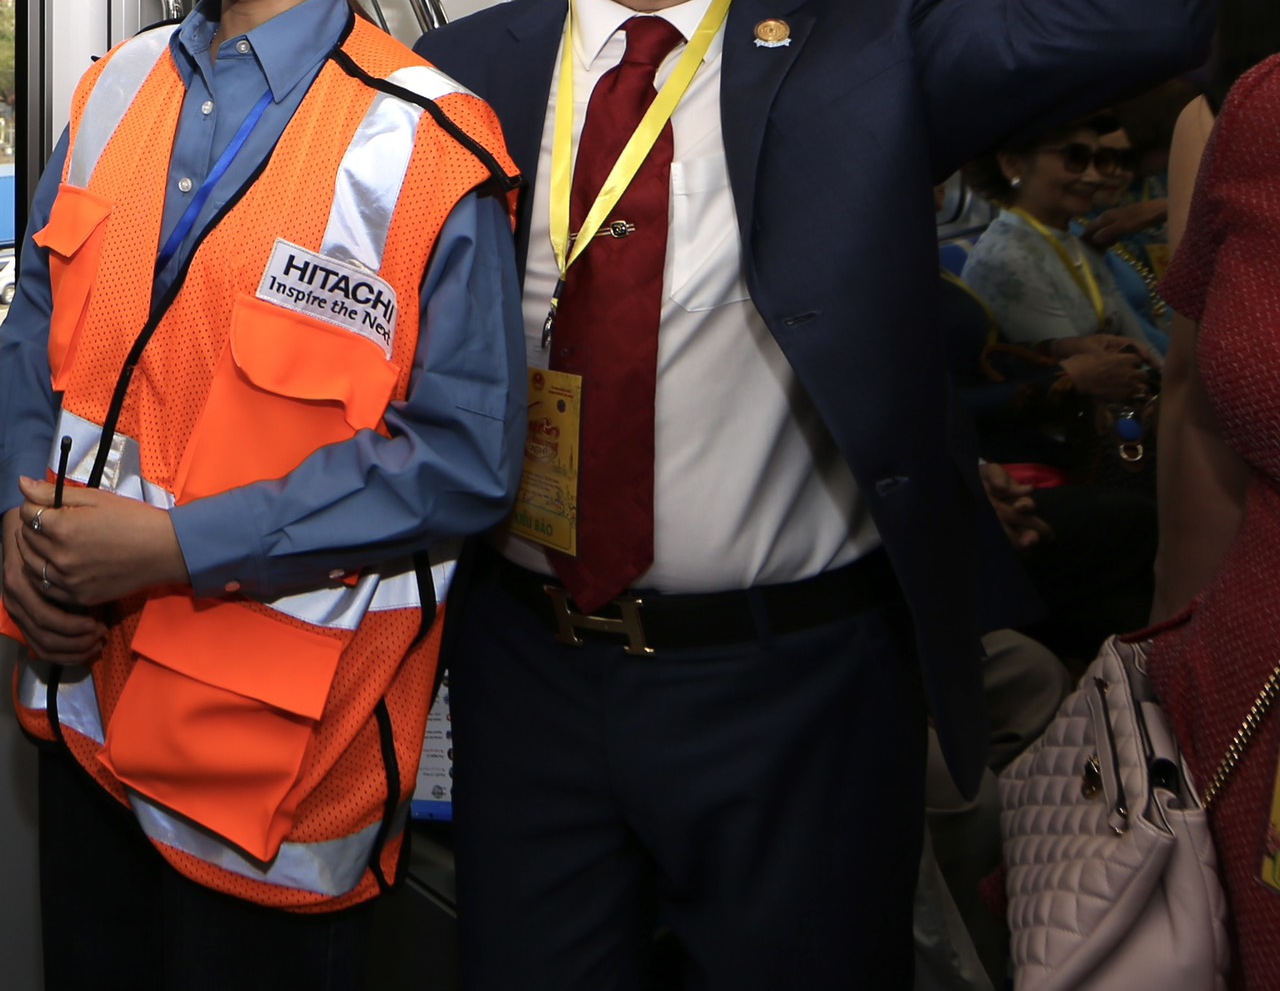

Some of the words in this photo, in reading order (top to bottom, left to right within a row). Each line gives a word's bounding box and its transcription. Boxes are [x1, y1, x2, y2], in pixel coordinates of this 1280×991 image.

[269, 275, 328, 309] Inspire
[331, 300, 358, 321] the
[362, 310, 392, 347] Next
[283, 254, 396, 325] HITACHI
